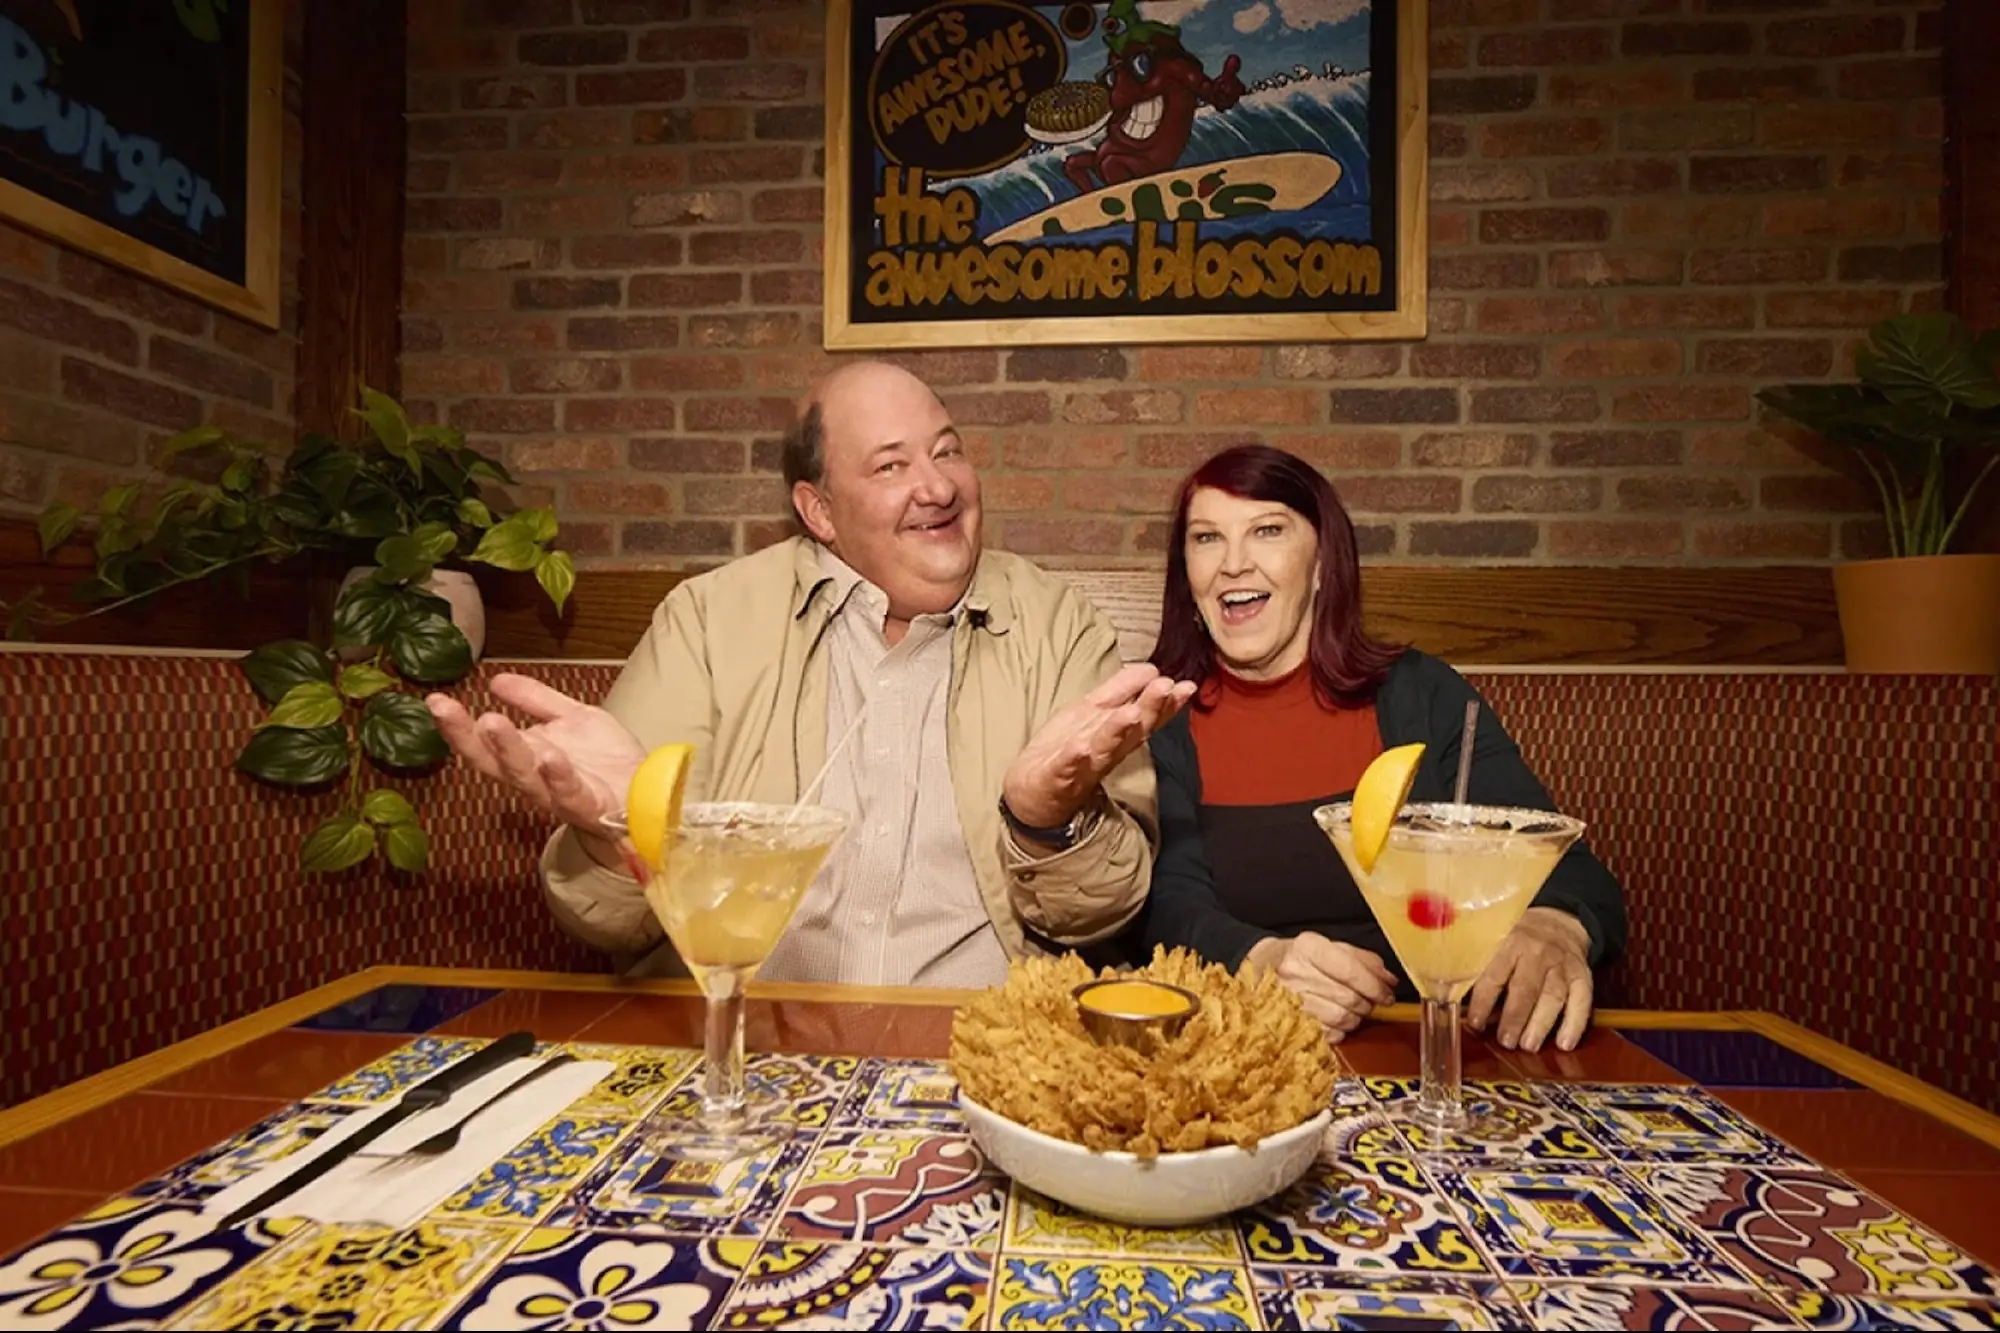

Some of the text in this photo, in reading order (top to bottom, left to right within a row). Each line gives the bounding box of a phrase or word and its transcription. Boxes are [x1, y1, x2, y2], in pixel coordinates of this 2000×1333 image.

[879, 20, 1047, 135] AWESOME,
[924, 67, 1027, 145] DUDE!
[0, 14, 226, 234] Burger
[874, 166, 976, 246] the
[865, 220, 1381, 307] awesome blossom
